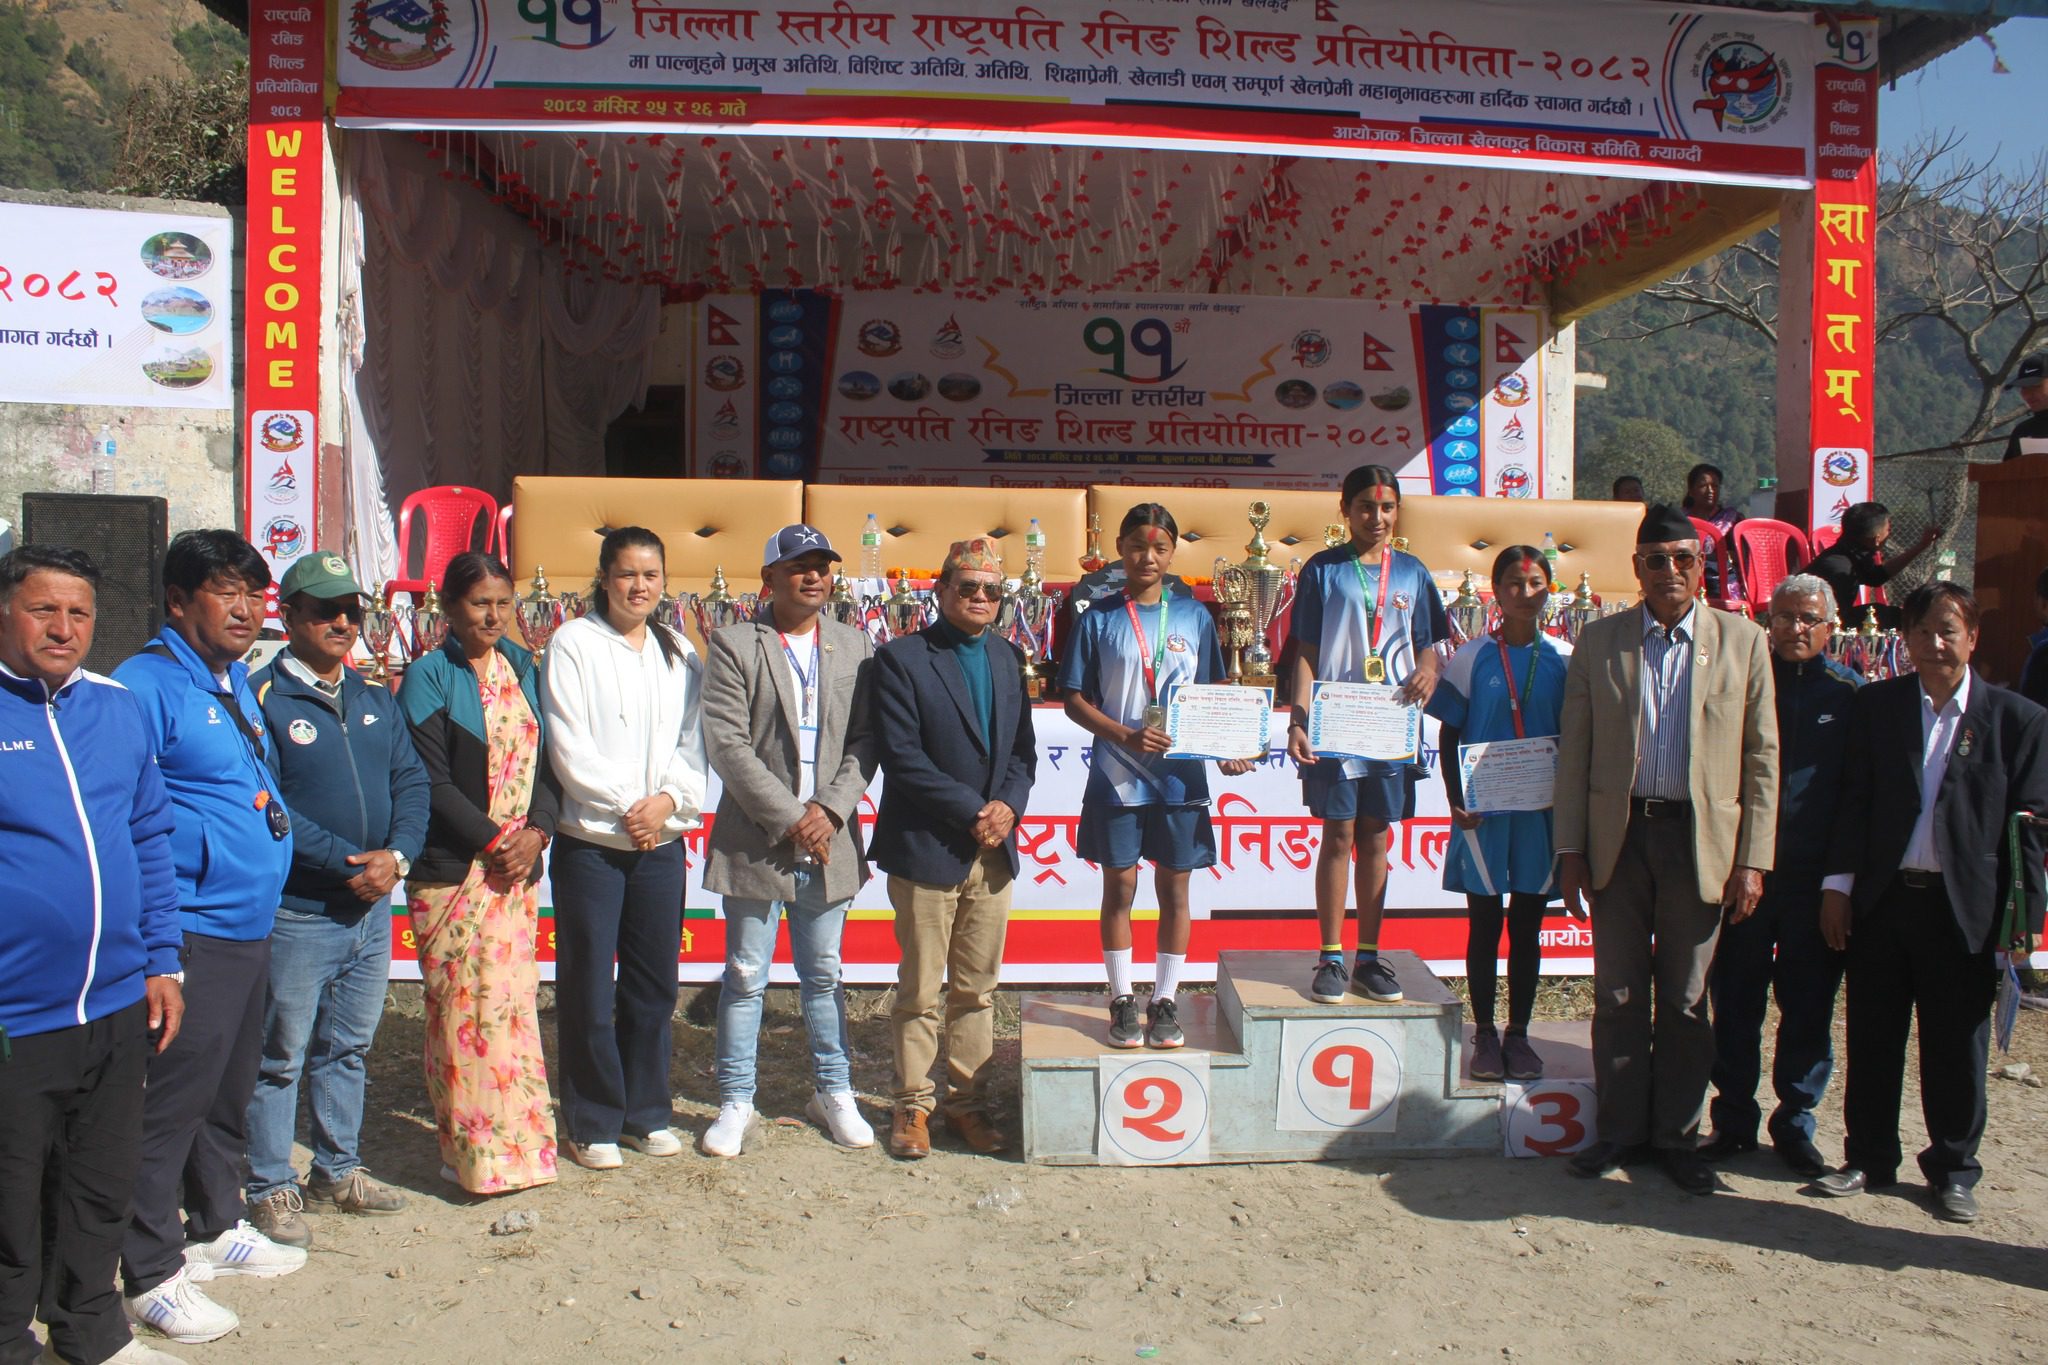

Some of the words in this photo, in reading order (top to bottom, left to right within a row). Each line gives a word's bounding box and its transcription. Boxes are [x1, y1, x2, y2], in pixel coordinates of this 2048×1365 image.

[263, 7, 312, 24] राष्ट्रपति
[631, 0, 760, 41] जिल्ला
[776, 0, 896, 49] स्तरीय
[911, 6, 1065, 56] राष्ट्रपति
[1080, 10, 1181, 60] रनिङ
[1196, 15, 1302, 63] शिल्ड
[255, 78, 318, 95] प्रतियोगिता
[629, 55, 650, 70] मा
[656, 52, 726, 76] पाल्नुहुने
[732, 56, 777, 77] प्रमुख
[848, 54, 904, 76] विशिष्ट
[1128, 67, 1186, 88] खेलाडी
[1191, 73, 1227, 93] एवम्
[1232, 74, 1284, 97] सम्पूर्ण
[1290, 76, 1353, 97] खेलप्रेमी
[1479, 88, 1529, 108] हार्दिक
[1534, 94, 1583, 113] स्वागत
[271, 105, 302, 117] २०८२
[544, 99, 587, 114] २०८२
[593, 95, 640, 116] मंसिर
[720, 99, 747, 118] गते
[1410, 127, 1463, 147] जिल्ला
[1535, 134, 1587, 155] विकास
[1649, 144, 1703, 163] म्याग्दी
[264, 130, 302, 388] WELCOME
[0, 329, 40, 345] ागत
[1054, 384, 1123, 406] जिल्ला
[1132, 385, 1206, 407] स्तरीय
[839, 407, 955, 448] राष्ट्रपति
[968, 408, 1043, 446] रनिङ
[1055, 410, 1137, 446] शिल्ड
[0, 740, 35, 750] LME
[1312, 1045, 1375, 1111] १
[1122, 1077, 1187, 1143] २
